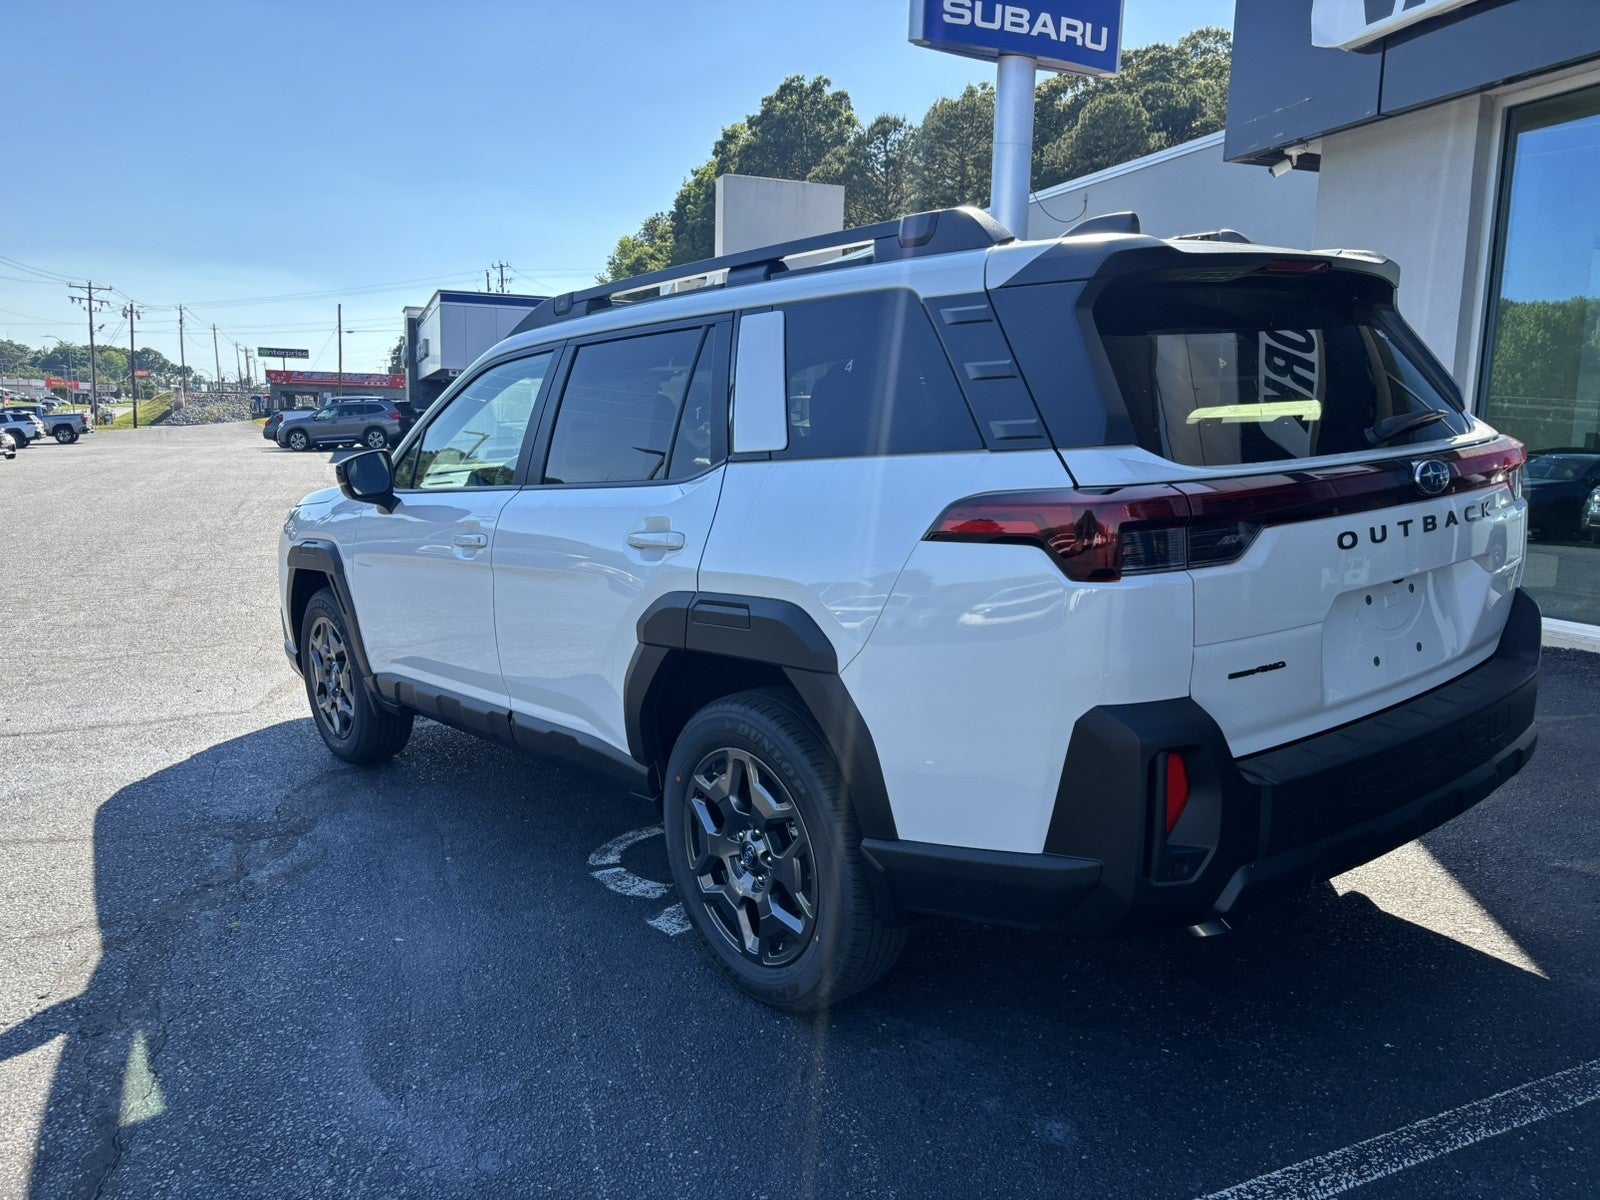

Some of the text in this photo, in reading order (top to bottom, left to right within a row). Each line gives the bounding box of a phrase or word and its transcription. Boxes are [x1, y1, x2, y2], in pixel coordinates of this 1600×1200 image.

[943, 0, 1108, 52] SUBARU
[261, 349, 309, 357] enterprise
[1337, 501, 1492, 550] OUTBACK
[737, 724, 806, 794] DUNLOP
